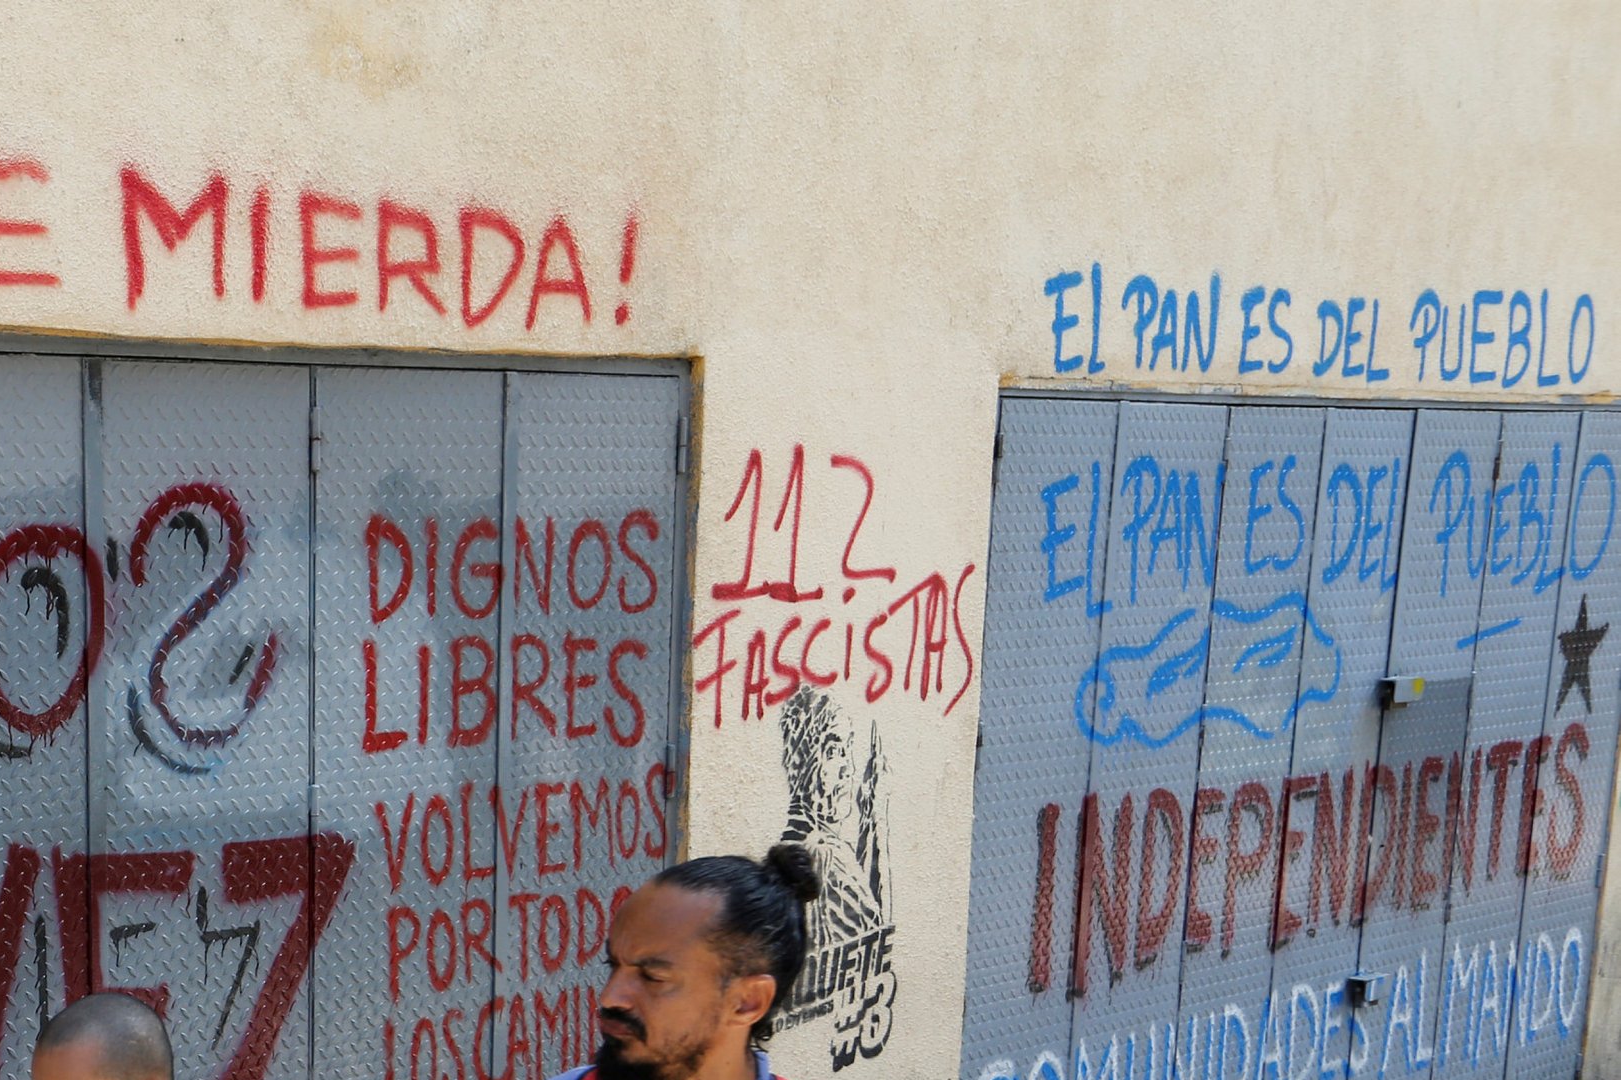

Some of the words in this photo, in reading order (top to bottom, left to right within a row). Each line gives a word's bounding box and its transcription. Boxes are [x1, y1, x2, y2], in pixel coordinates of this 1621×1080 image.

[120, 162, 639, 330] MIERDA!
[1121, 270, 1221, 374] PAN
[1238, 284, 1293, 376] ES
[1312, 297, 1390, 384] DEL
[1409, 287, 1595, 390] PUEBLO
[364, 508, 660, 626] DIGNOS
[1040, 461, 1113, 618] EL
[1121, 455, 1225, 603] PAN
[1244, 453, 1305, 577] ES
[1321, 457, 1401, 594] DEL
[1429, 442, 1617, 598] PUEBLO
[362, 630, 647, 754] LIBRES
[374, 762, 676, 895] VOLVEMOS
[1027, 722, 1591, 1000] INDEPENDIENTES
[387, 898, 503, 1008] POR
[1439, 926, 1583, 1070] MANDO
